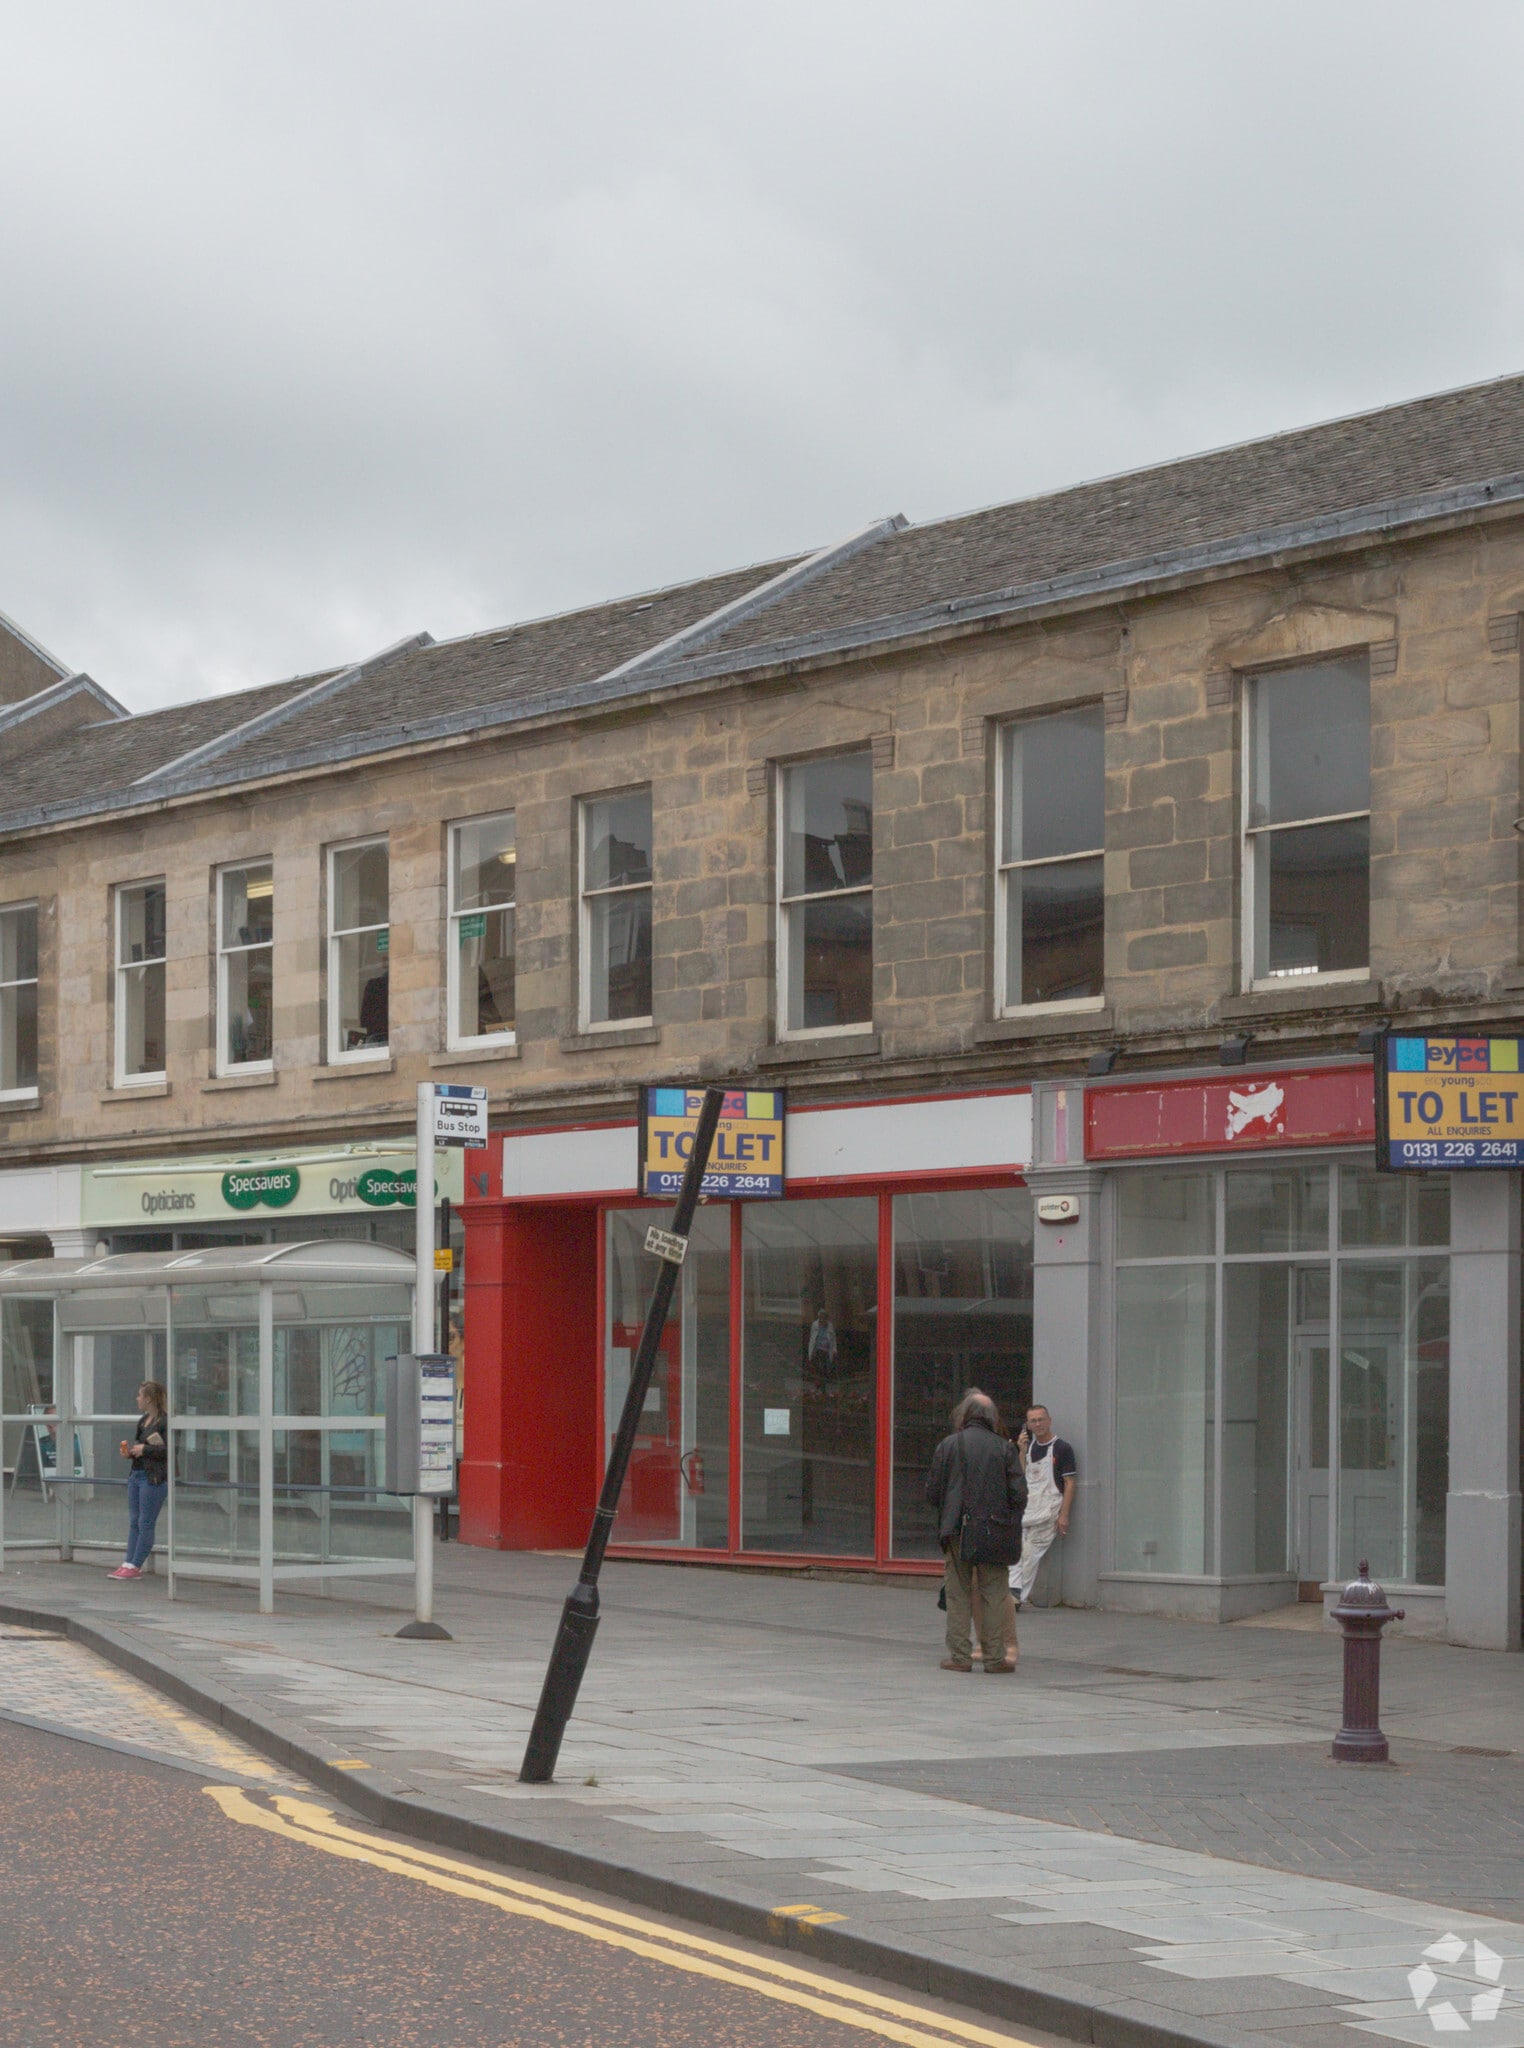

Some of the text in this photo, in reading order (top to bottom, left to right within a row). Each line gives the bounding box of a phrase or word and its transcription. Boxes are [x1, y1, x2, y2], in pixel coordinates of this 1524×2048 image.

[1426, 1045, 1489, 1066] eyco
[1397, 1090, 1519, 1124] TO LET
[437, 1120, 481, 1134] Bus Stop
[1427, 1126, 1492, 1136] ALL ENQUIRIES
[654, 1131, 776, 1161] TO LET
[1403, 1142, 1517, 1157] 0131 226 2641
[229, 1174, 291, 1196] Specsavers
[329, 1177, 359, 1204] Opti
[366, 1178, 418, 1196] Specsave
[701, 1175, 729, 1187] 226
[735, 1176, 770, 1188] 2641
[141, 1190, 196, 1215] Opticians
[650, 1230, 685, 1251] No loading
[655, 1243, 667, 1255] any
